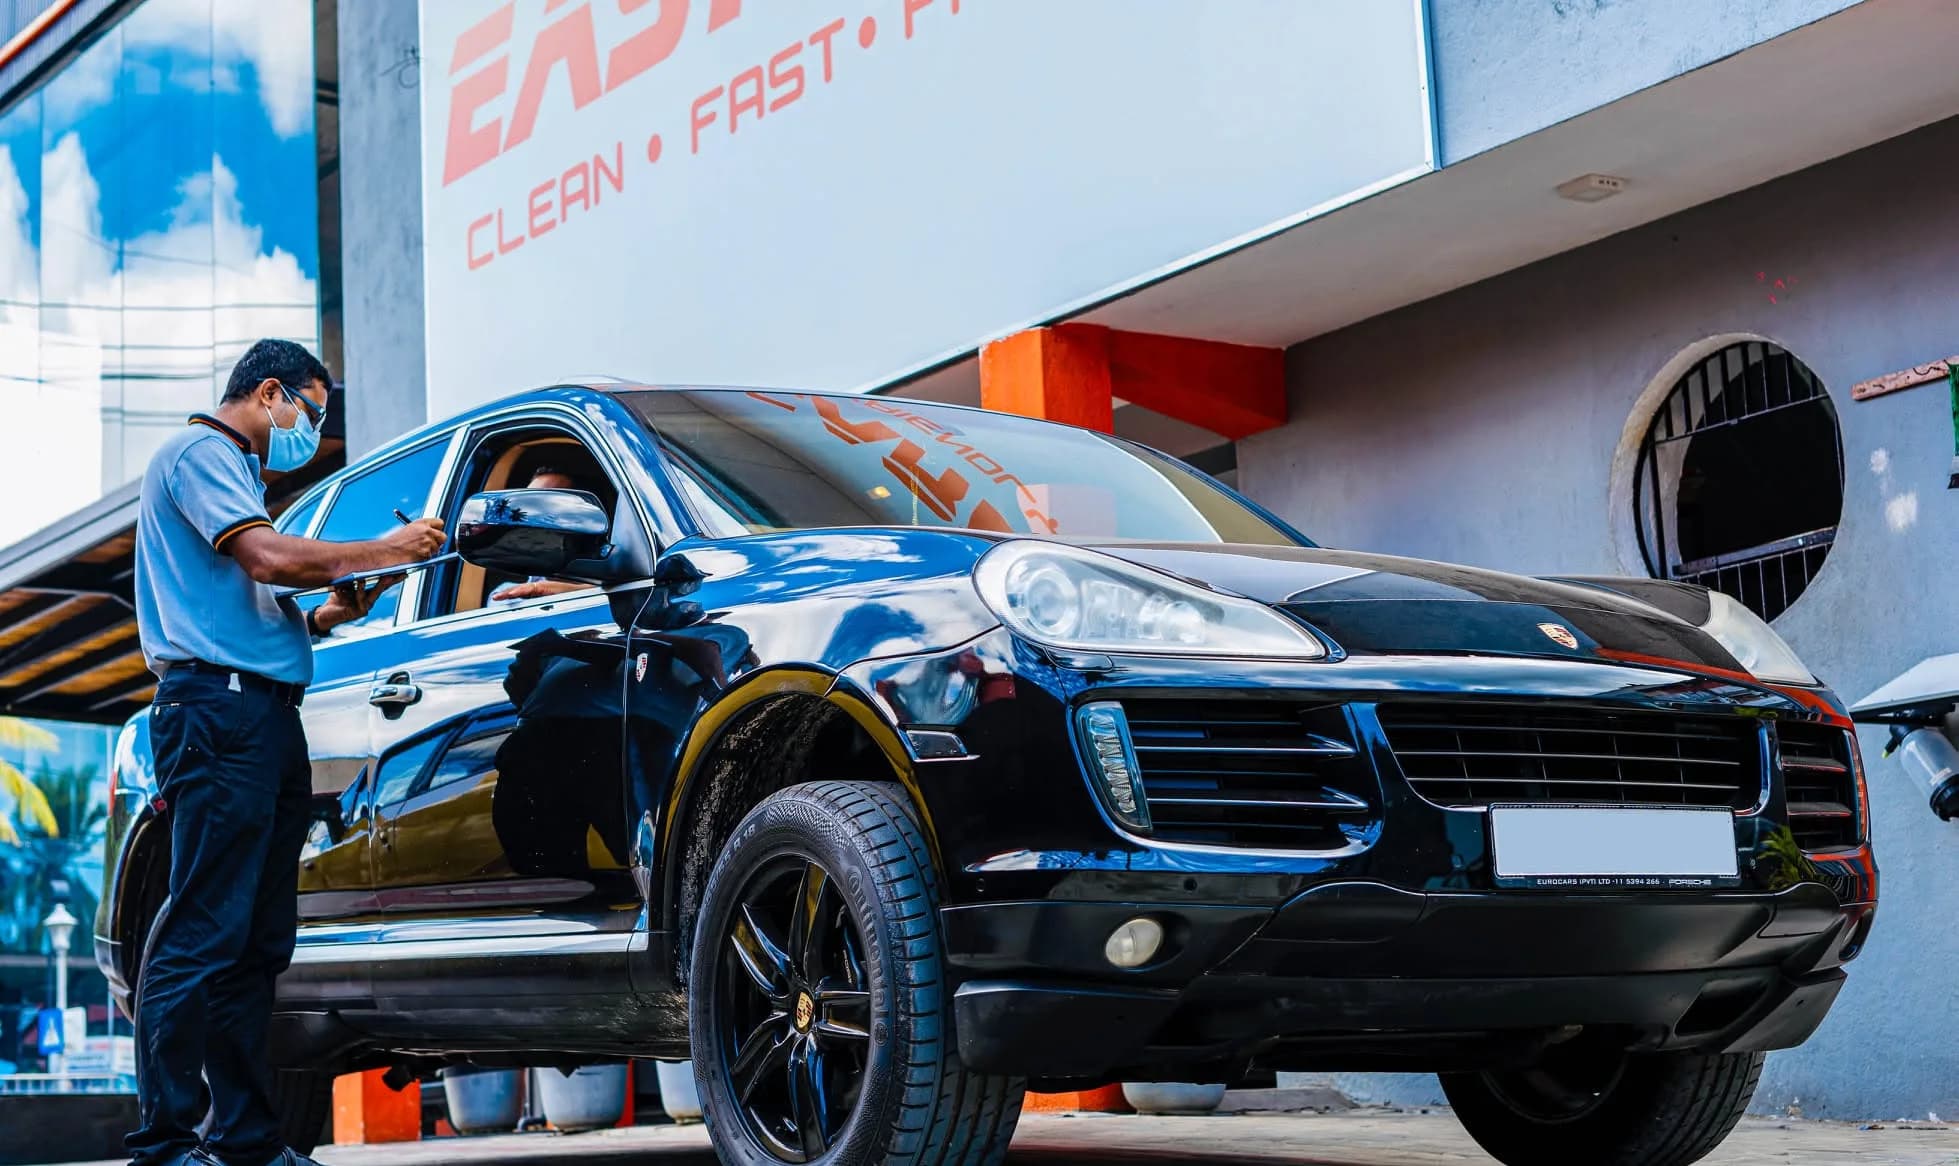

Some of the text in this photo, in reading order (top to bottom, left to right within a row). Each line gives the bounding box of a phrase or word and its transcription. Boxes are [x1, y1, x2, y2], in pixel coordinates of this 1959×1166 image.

[443, 0, 742, 187] EAS
[467, 17, 845, 271] CLEAN FAST
[1536, 877, 1578, 886] EUROCARS
[1598, 877, 1611, 886] LTD
[1668, 878, 1712, 887] PORSCHE
